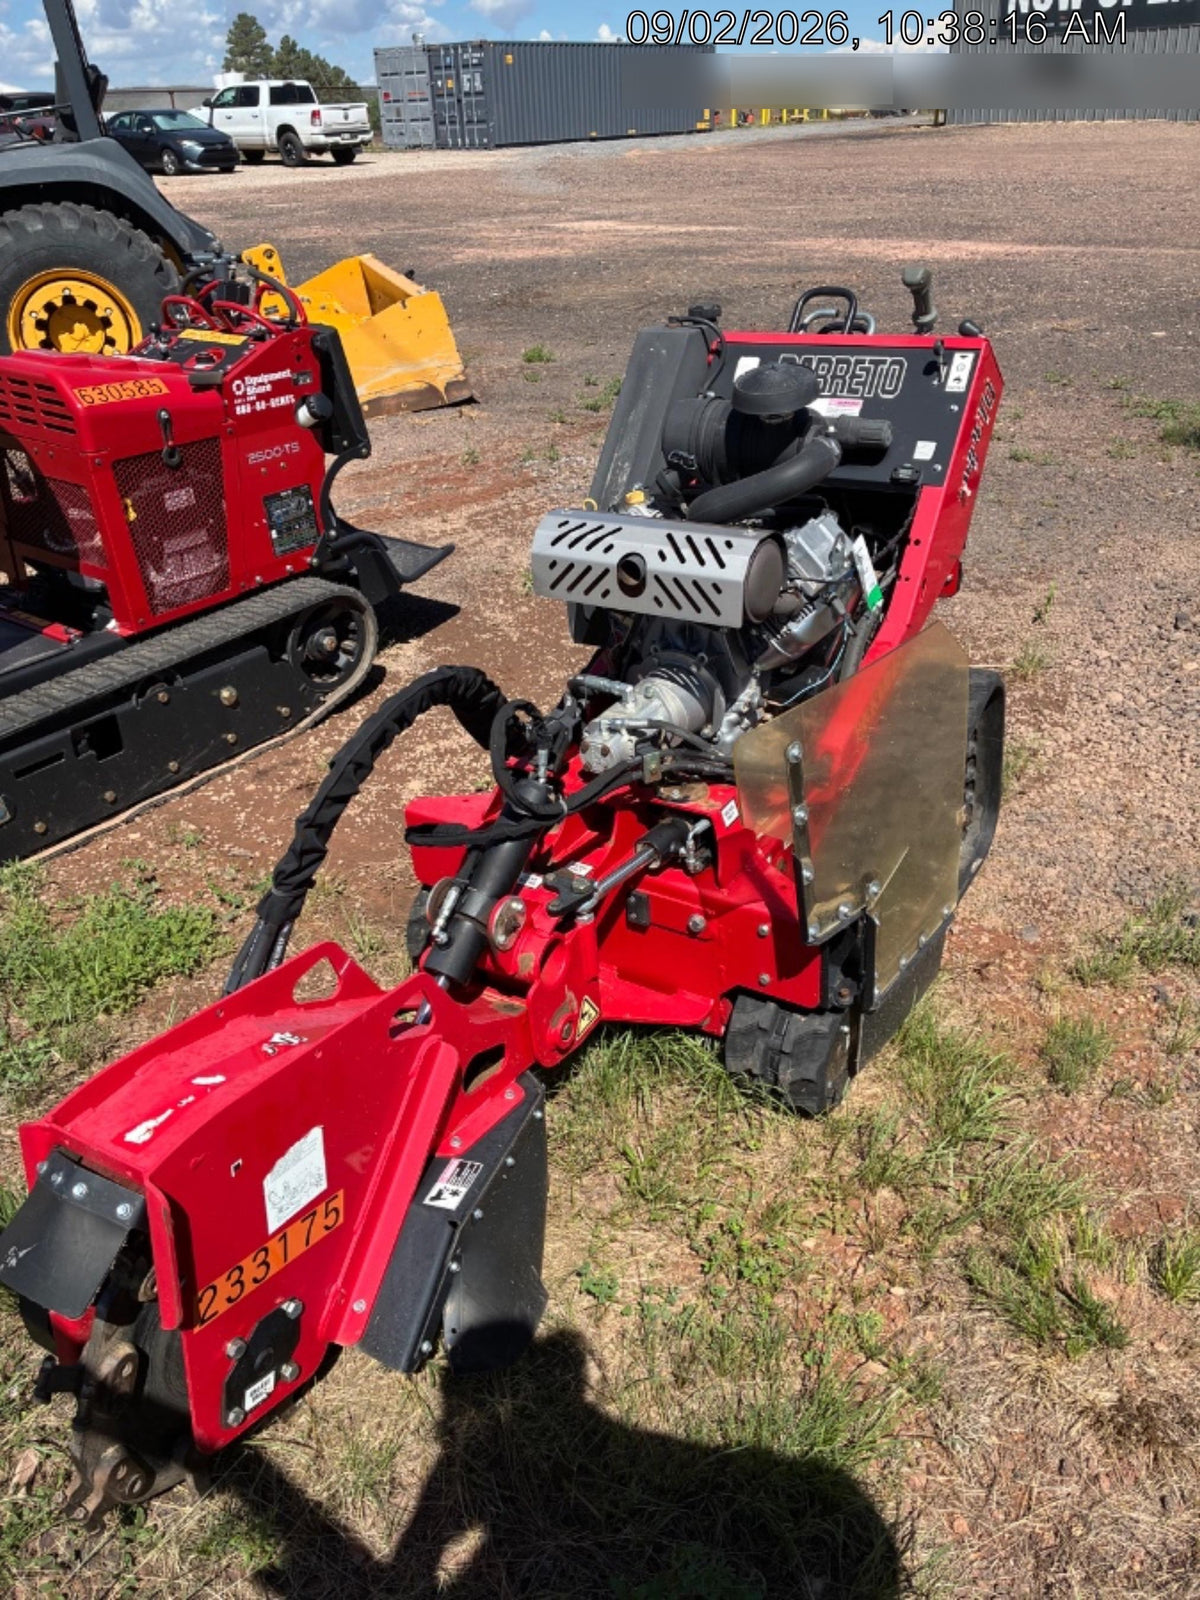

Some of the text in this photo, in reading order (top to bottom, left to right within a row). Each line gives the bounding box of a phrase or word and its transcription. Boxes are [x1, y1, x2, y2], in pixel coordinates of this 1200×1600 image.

[78, 380, 163, 405] 630585
[778, 353, 908, 399] RRETO
[196, 1193, 342, 1327] 233175
